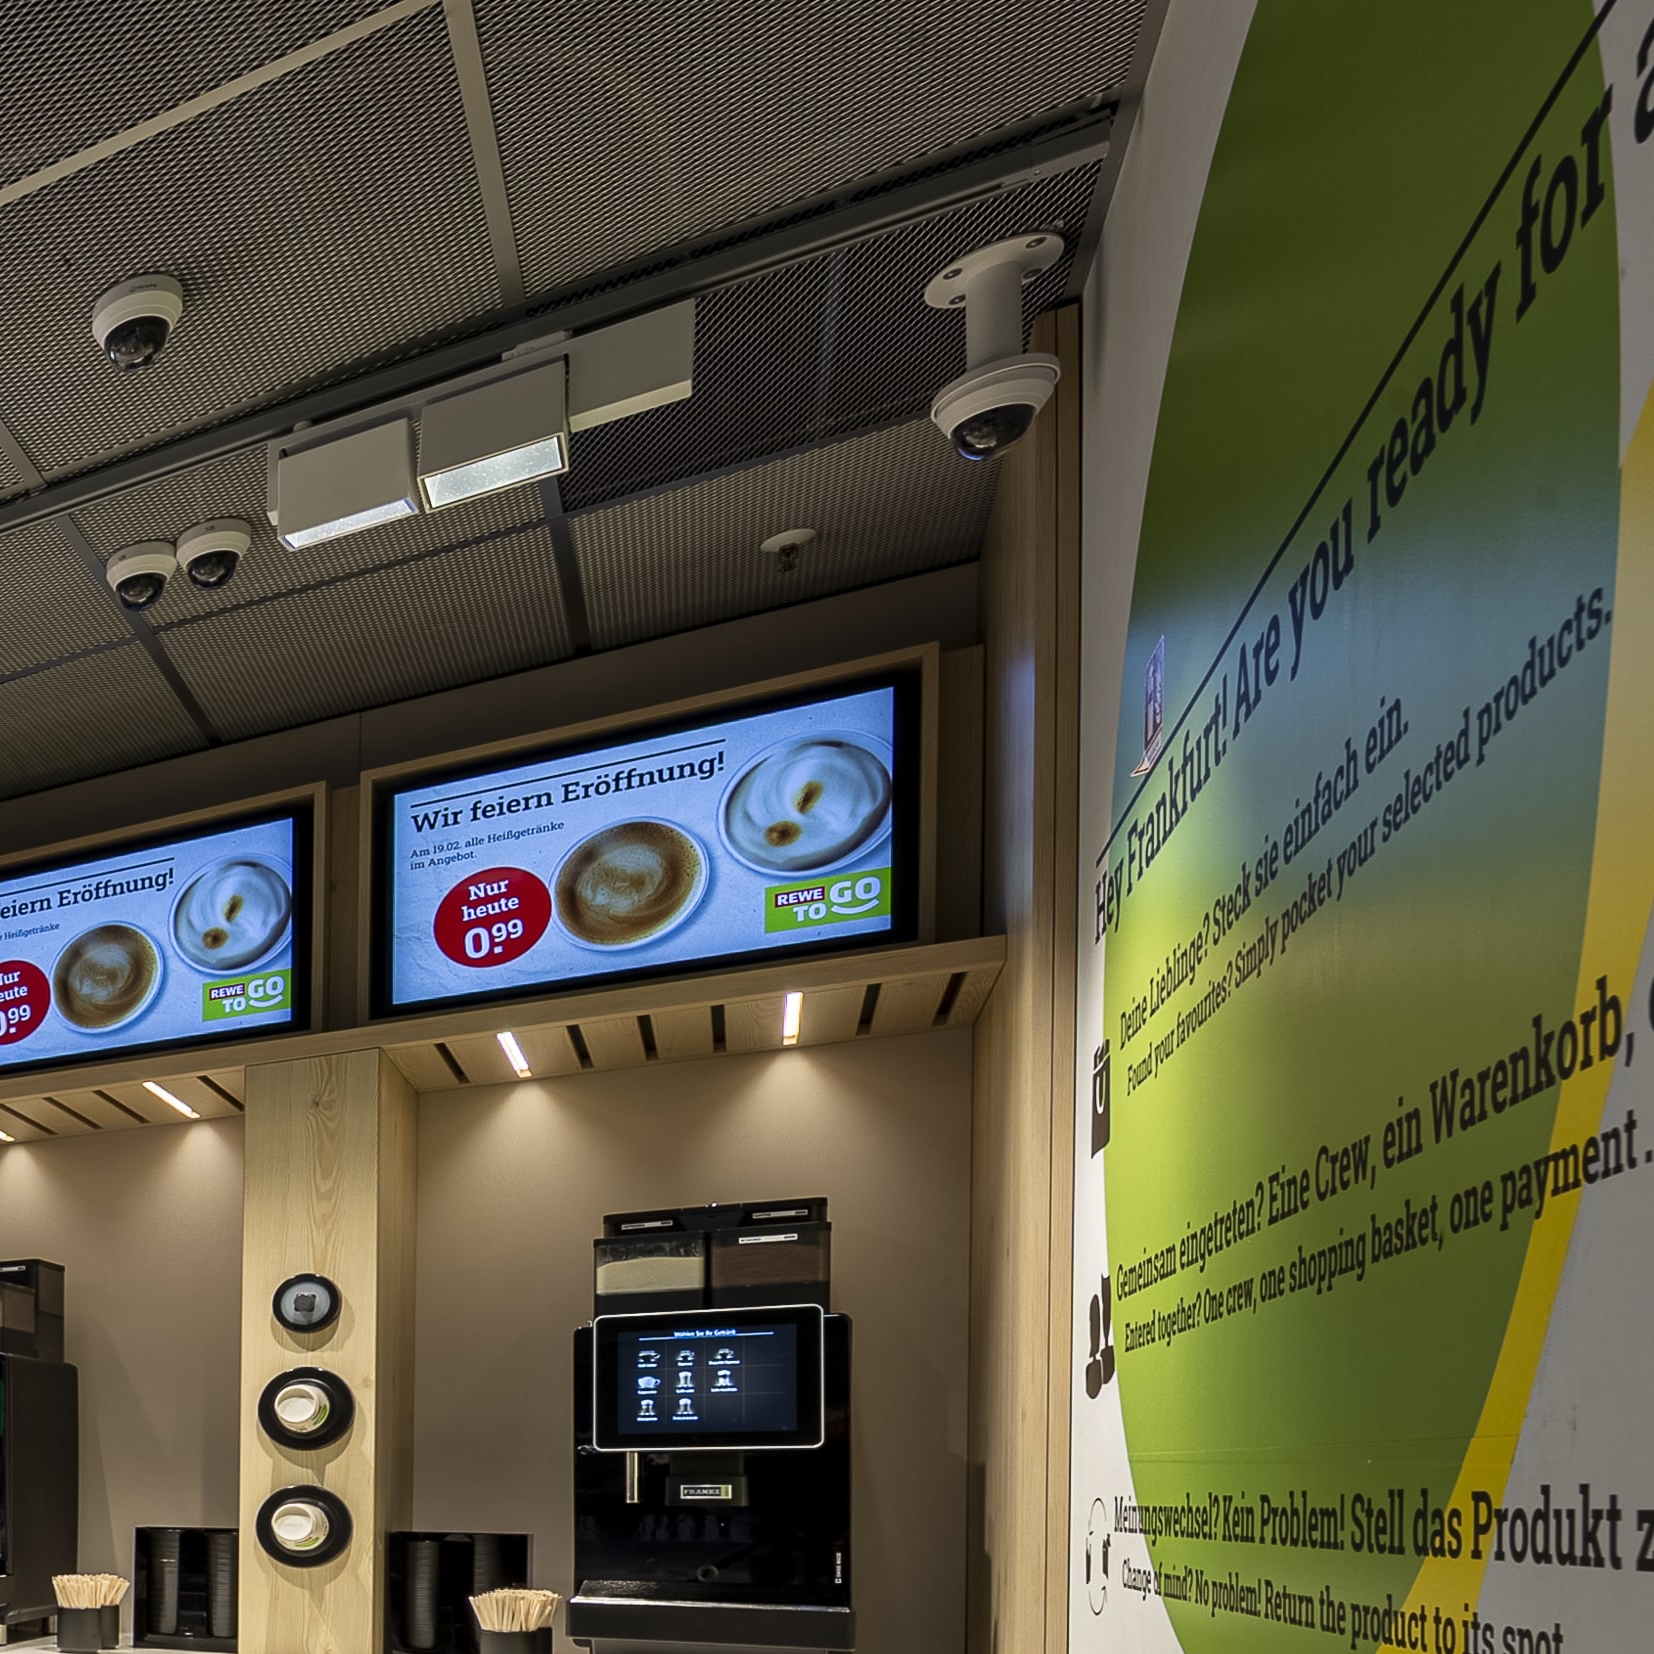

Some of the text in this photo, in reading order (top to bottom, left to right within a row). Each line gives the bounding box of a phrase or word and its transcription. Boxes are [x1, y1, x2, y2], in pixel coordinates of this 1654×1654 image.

[1095, 83, 1613, 945] Hey Frankfurt! Are you ready for
[410, 751, 726, 832] Wir feiern Eröffnung!
[410, 848, 431, 858] Am
[464, 836, 485, 847] alle
[488, 820, 565, 844] Heißgetränke
[410, 850, 478, 870] im Angebot.
[1127, 586, 1613, 1097] Found your favourites? Simply pocket your selected products.
[57, 867, 175, 908] Eröffnung!
[468, 878, 511, 901] Nur
[777, 876, 882, 922] REWE TO GO
[1120, 695, 1409, 1051] Deine Lieblinge? Steck sie einfach ein.
[3, 921, 61, 941] Heißgetränke
[461, 894, 520, 922] heute
[209, 974, 285, 1013] REWE TO GO
[1117, 1247, 1177, 1302] Gemeinsam
[1179, 1180, 1265, 1273] eingetreten?
[1267, 1164, 1310, 1226] Eine
[1315, 1134, 1376, 1202] Crew,
[1383, 1095, 1423, 1169] ein
[1429, 974, 1635, 1144] Warenkorb,
[1124, 1308, 1156, 1353] Entered
[1157, 1291, 1202, 1347] together?
[1203, 1288, 1224, 1325] One
[1225, 1276, 1257, 1314] crew,
[1259, 1264, 1286, 1303] one
[1288, 1228, 1367, 1296] shopping
[1370, 1194, 1443, 1264] basket,
[1450, 1179, 1494, 1234] one
[1114, 1491, 1220, 1548] Meinungswechsel?
[1222, 1490, 1256, 1544] Kein
[1259, 1490, 1346, 1551] Problem!
[1351, 1488, 1406, 1555] Stell
[1413, 1487, 1463, 1560] das
[1470, 1482, 1623, 1571] Produkt
[1121, 1556, 1152, 1602] Change
[1153, 1562, 1163, 1597] of
[1164, 1564, 1193, 1603] mind?
[1194, 1569, 1210, 1607] No
[1211, 1571, 1262, 1618] problem!
[1264, 1578, 1315, 1630] Return
[1319, 1585, 1346, 1636] the
[1350, 1593, 1428, 1653] product
